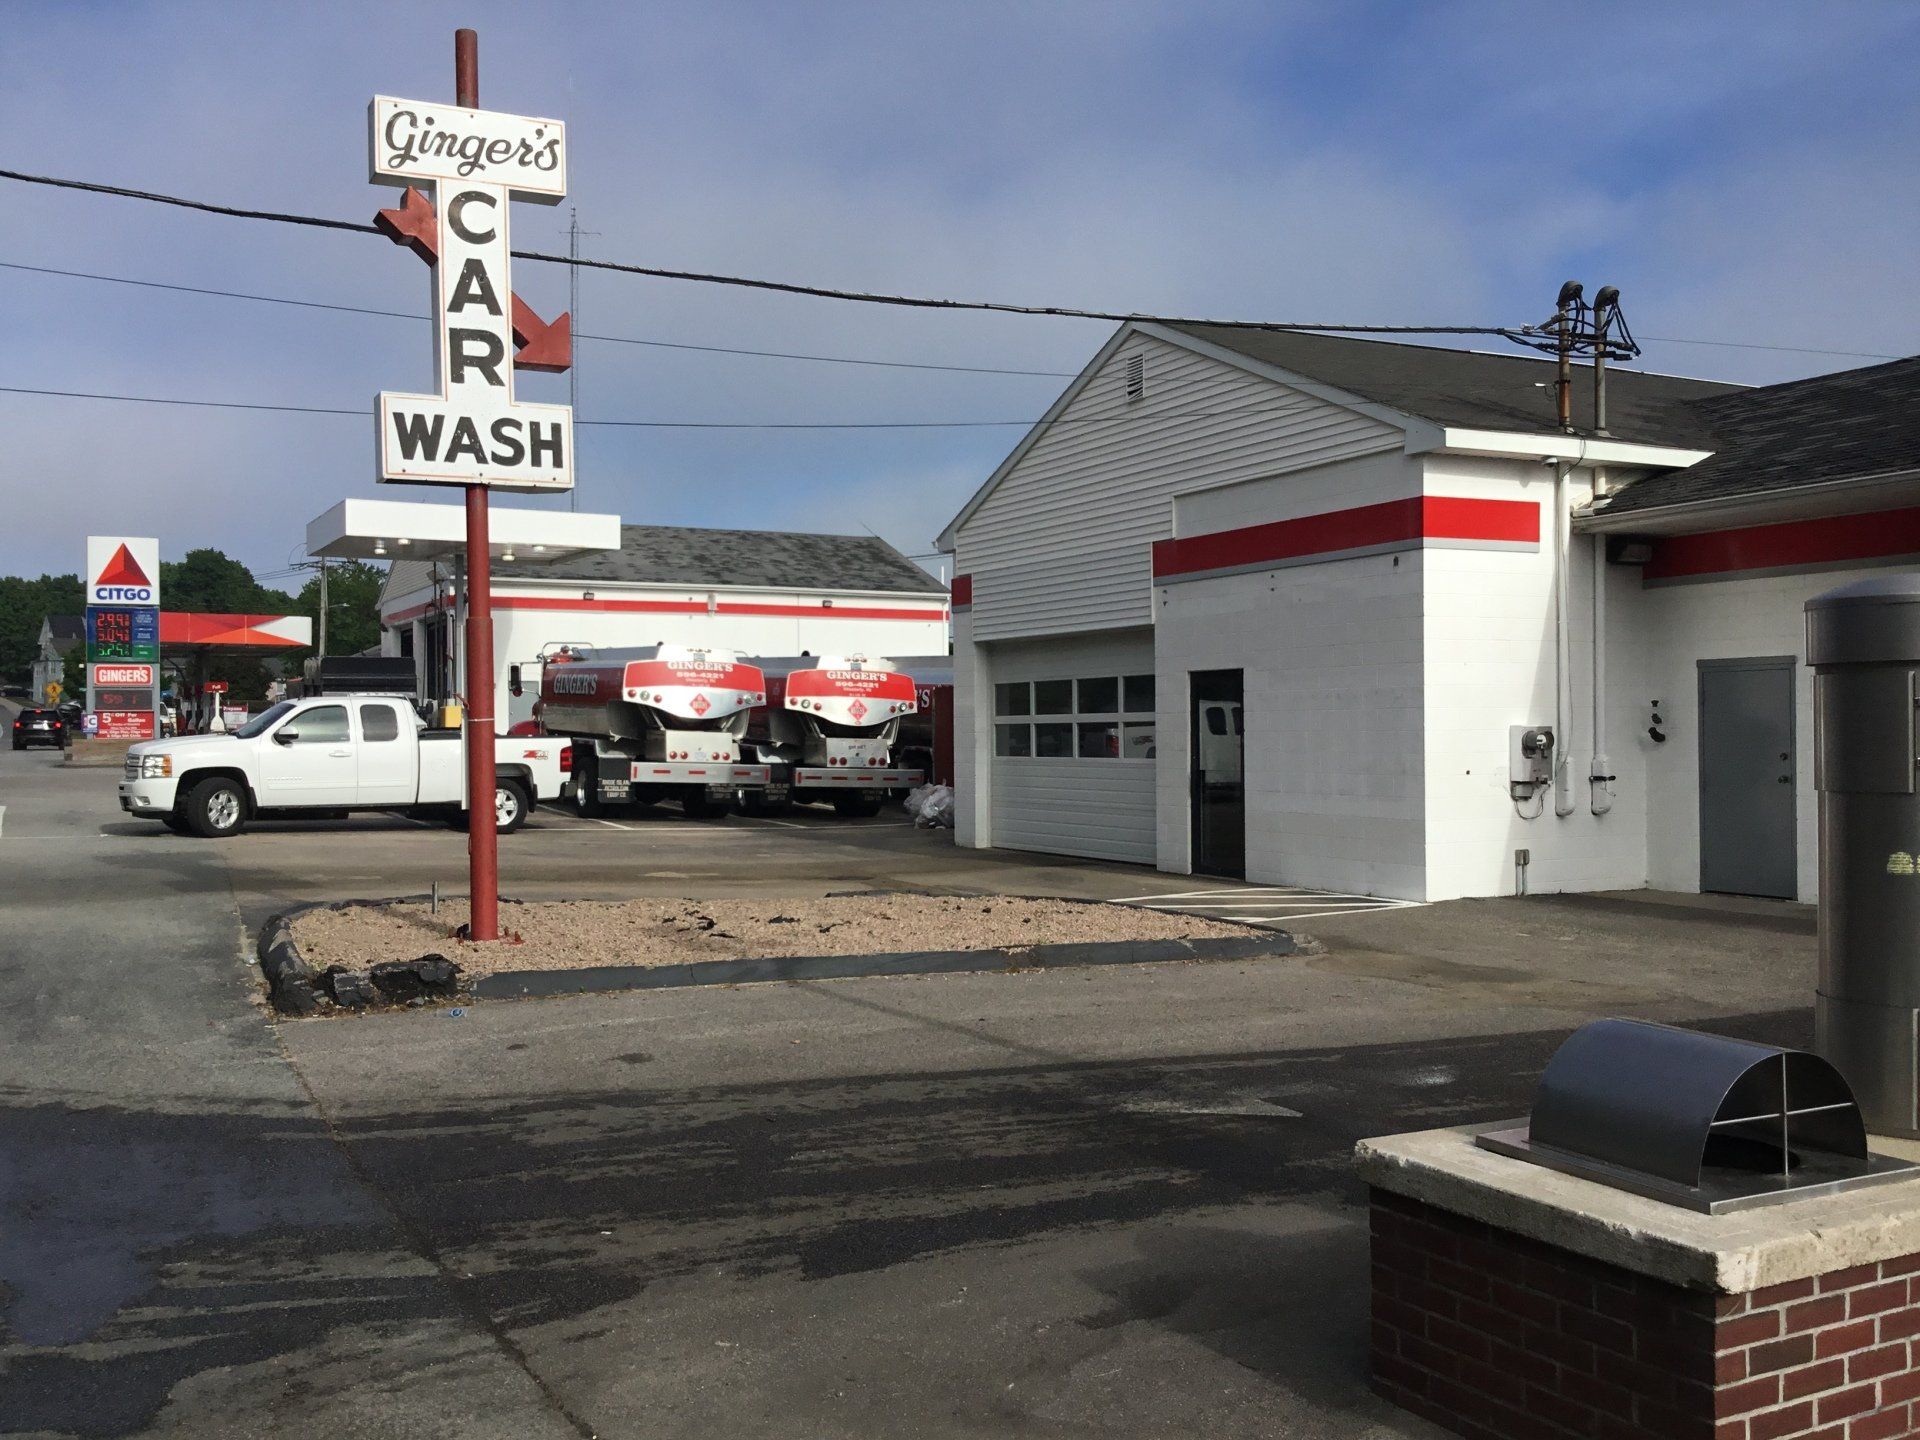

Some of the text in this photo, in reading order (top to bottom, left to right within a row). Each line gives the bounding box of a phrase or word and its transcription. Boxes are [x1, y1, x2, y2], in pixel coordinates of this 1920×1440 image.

[385, 110, 560, 176] Ginger's
[447, 190, 506, 387] CAR
[393, 411, 564, 469] WASH
[96, 587, 151, 601] CITGO
[99, 667, 149, 683] GINGER'S
[667, 661, 734, 673] GINGER'S
[826, 671, 888, 682] GINGER'S
[553, 673, 598, 695] GINGER'S
